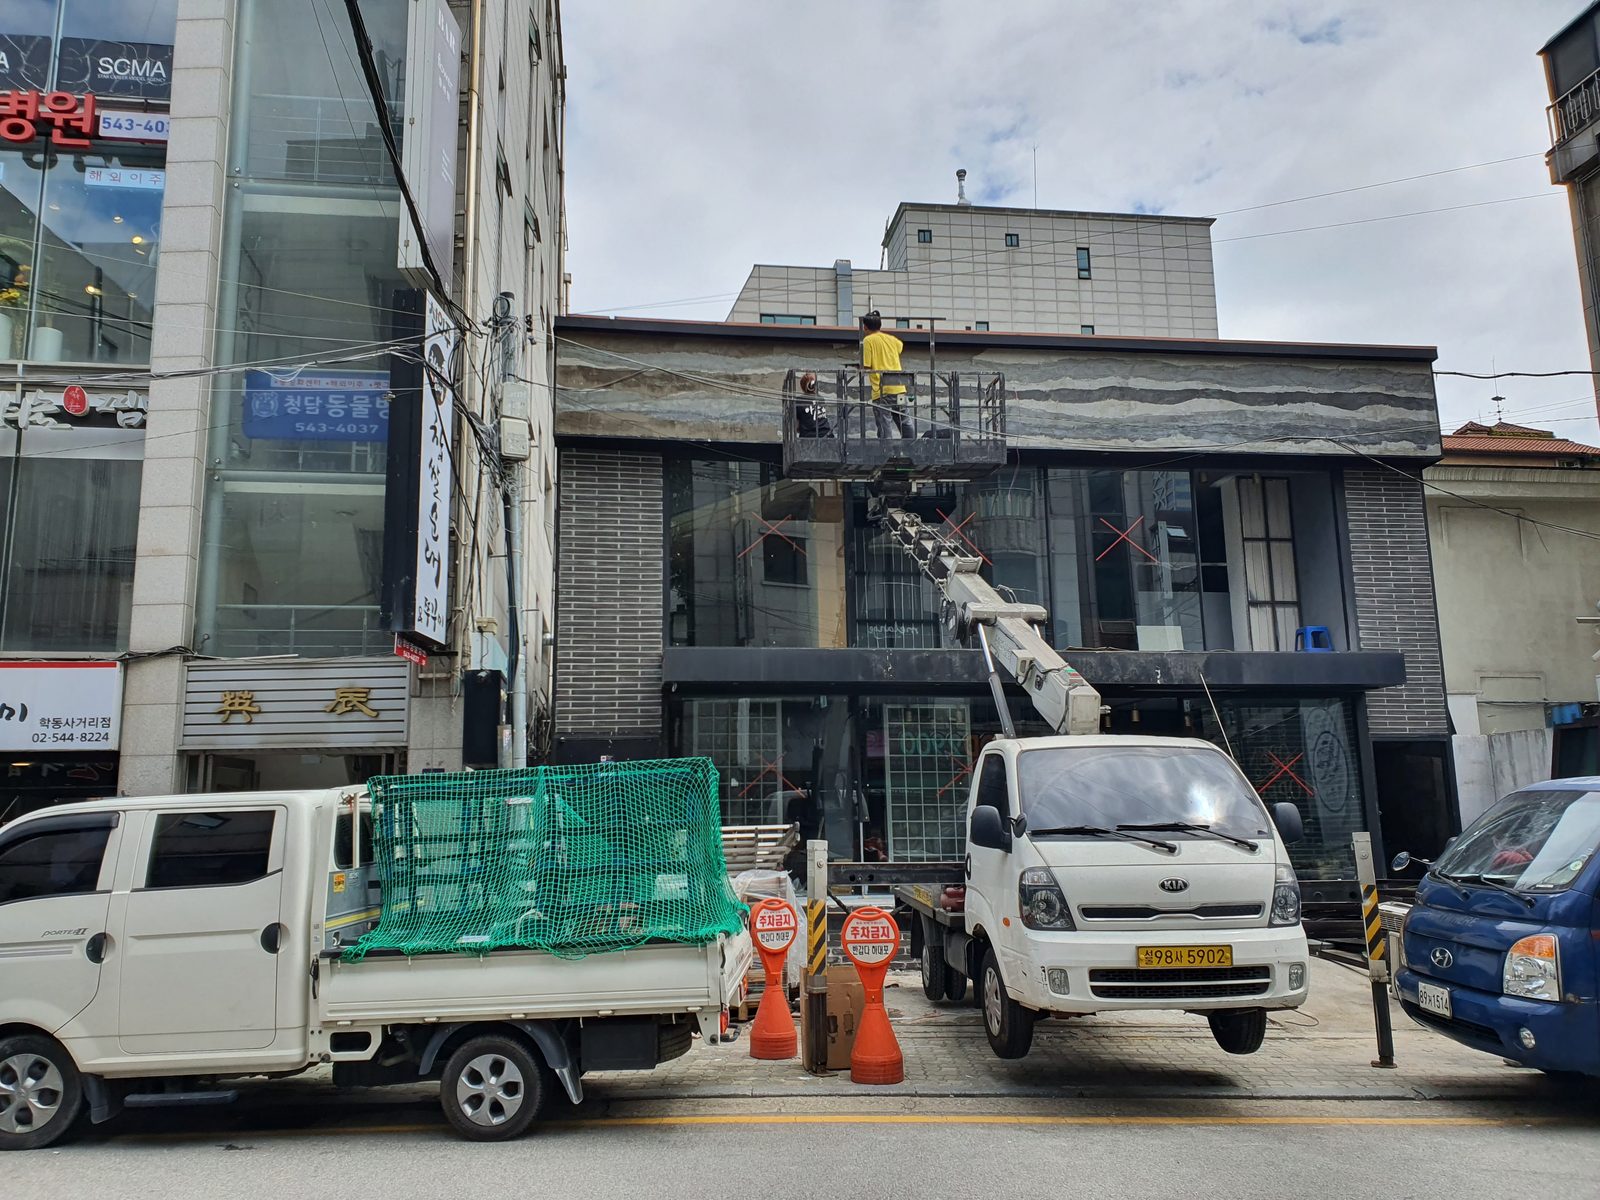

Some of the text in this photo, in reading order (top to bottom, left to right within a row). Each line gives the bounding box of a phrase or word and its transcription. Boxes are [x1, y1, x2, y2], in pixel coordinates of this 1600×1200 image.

[97, 57, 167, 78] SCMA
[102, 117, 170, 133] 543-40
[295, 422, 379, 434] 543-4037
[39, 716, 112, 730] 학동사거리점
[1163, 880, 1185, 890] KIA
[759, 913, 791, 928] 주차금지
[850, 926, 890, 939] 주차금지
[1187, 949, 1226, 964] 5902
